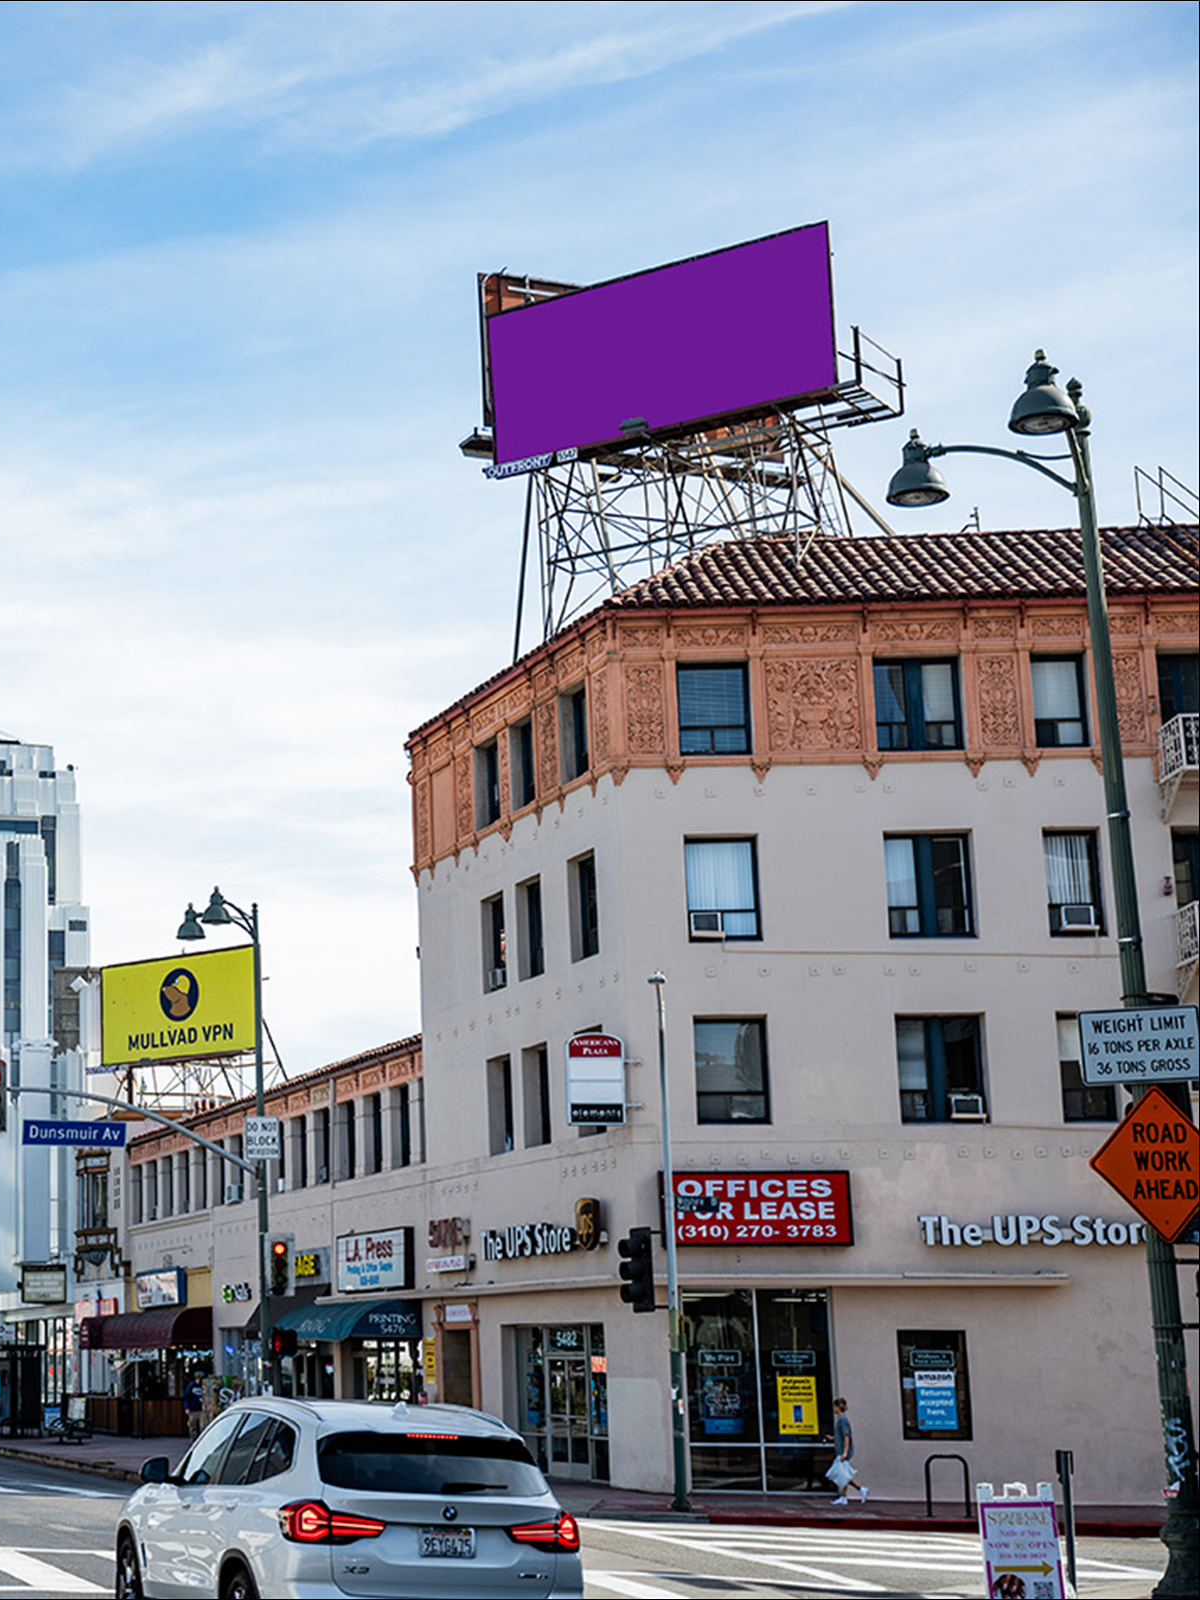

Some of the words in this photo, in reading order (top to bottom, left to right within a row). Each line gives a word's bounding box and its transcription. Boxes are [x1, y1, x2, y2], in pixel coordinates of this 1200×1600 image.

[1091, 1016, 1143, 1034] WEIGHT
[1150, 1015, 1186, 1031] LIMIT
[128, 1027, 198, 1051] MULLVAD
[202, 1023, 234, 1042] VPN
[572, 1038, 619, 1047] AMERICANA
[583, 1047, 609, 1055] PLAZA
[1087, 1043, 1099, 1055] 16
[1103, 1040, 1133, 1055] TONS
[1137, 1039, 1161, 1052] PER
[1165, 1037, 1195, 1051] AXLE
[1097, 1062, 1112, 1075] 36
[1117, 1060, 1146, 1074] TONS
[1151, 1058, 1191, 1073] GROSS
[29, 1125, 99, 1140] Dunsmuir
[102, 1127, 121, 1140] Av
[247, 1122, 258, 1132] DO
[1133, 1123, 1187, 1144] ROAD
[247, 1135, 276, 1146] BLOCK
[1133, 1150, 1191, 1172] WORK
[677, 1179, 833, 1198] OFFICES
[1133, 1179, 1199, 1200] AHEAD
[744, 1201, 836, 1220] LEASE
[677, 1225, 730, 1241] (310)
[736, 1225, 780, 1238] 270-
[787, 1225, 837, 1238] 3783
[919, 1215, 983, 1246] The
[992, 1214, 1063, 1246] UPS
[1072, 1214, 1148, 1246] Stor
[346, 1239, 362, 1262] L.A.
[366, 1236, 393, 1260] Press
[479, 1230, 503, 1261] The
[505, 1224, 532, 1258] UPS
[534, 1222, 571, 1256] Store
[368, 1313, 416, 1325] PRINTING
[380, 1323, 406, 1335] 5476
[556, 1330, 577, 1347] 5482
[919, 1399, 954, 1408] accepted
[926, 1408, 947, 1416] here.
[1028, 1541, 1056, 1549] OPEN
